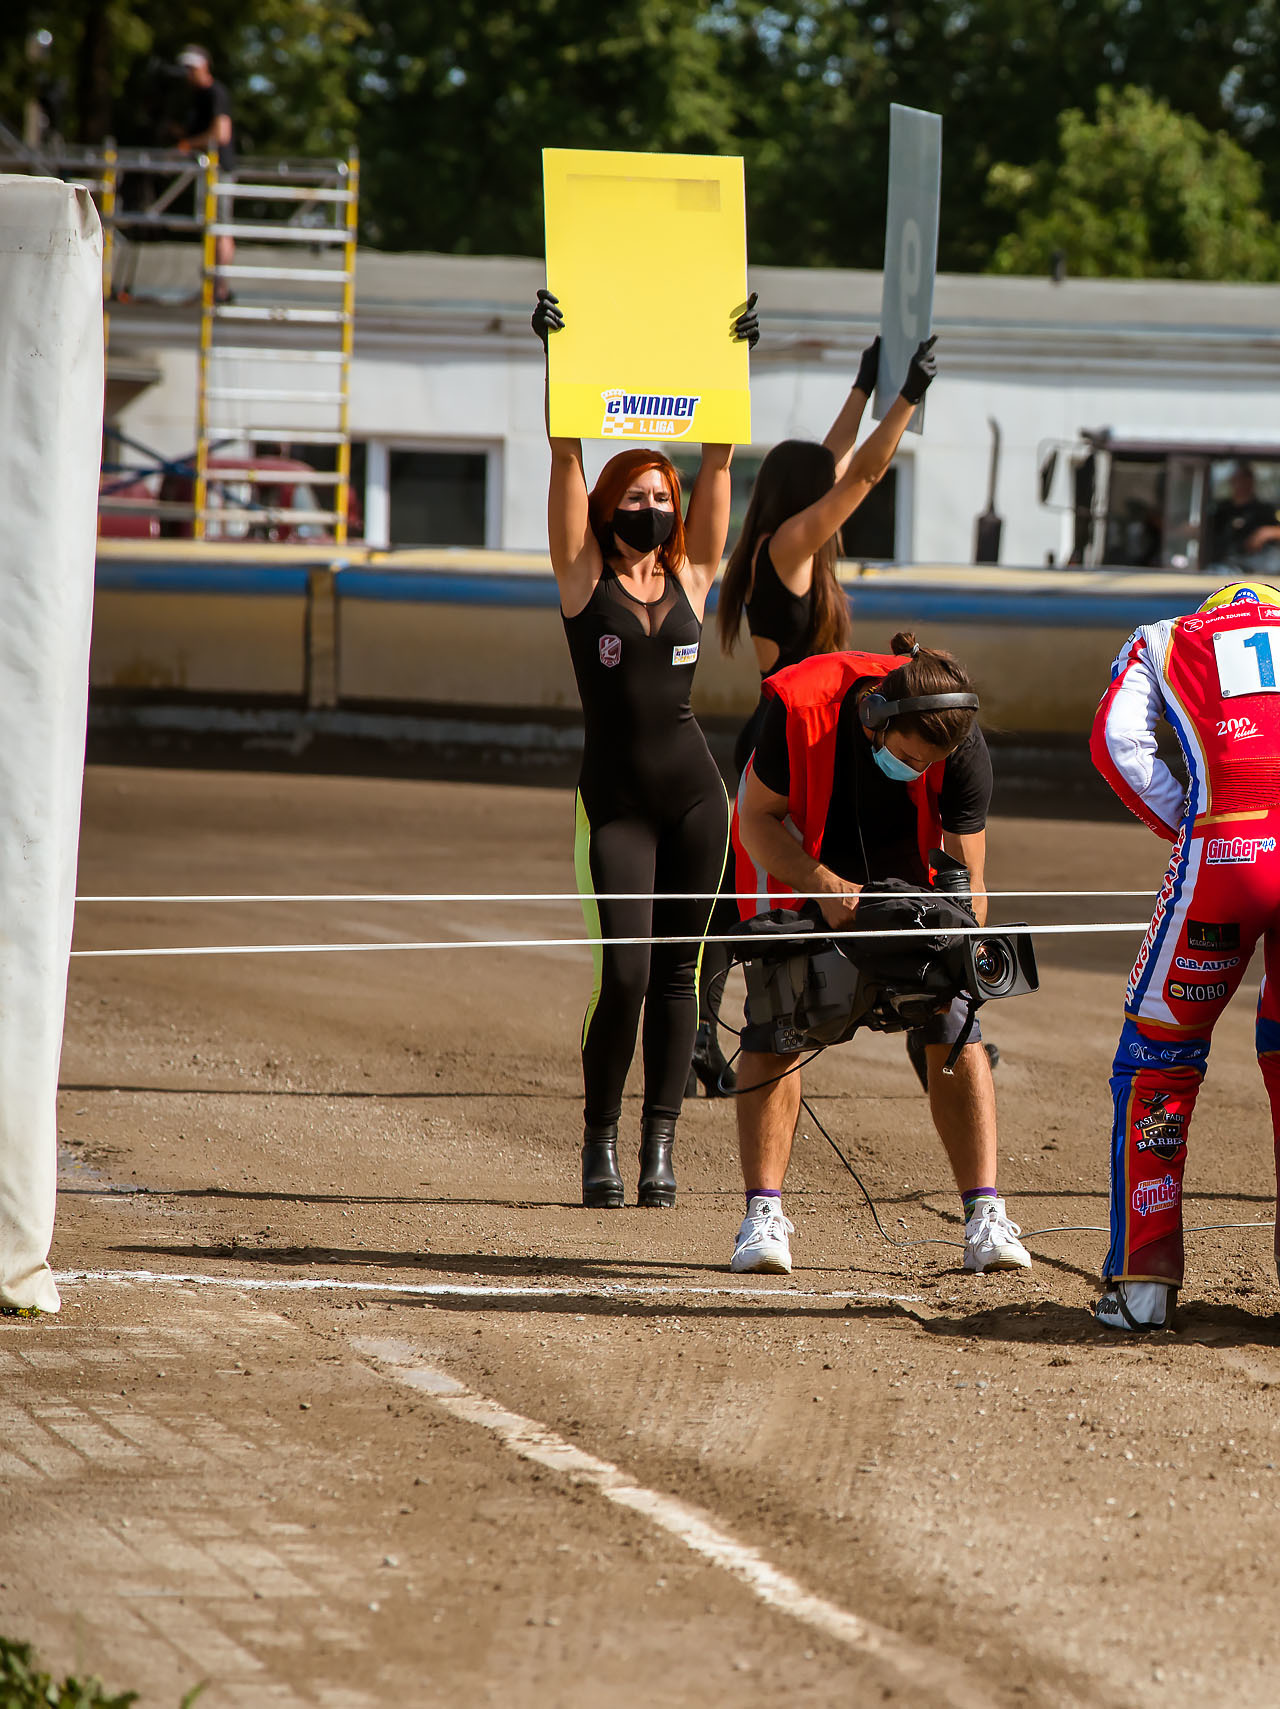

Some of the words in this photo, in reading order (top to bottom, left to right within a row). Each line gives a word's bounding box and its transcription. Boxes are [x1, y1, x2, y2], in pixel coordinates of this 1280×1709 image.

[607, 395, 699, 416] eWinner
[639, 420, 647, 432] 1.
[648, 420, 675, 433] LIGA
[1243, 632, 1276, 687] 1
[1207, 838, 1260, 861] GinGer
[1202, 957, 1239, 971] AUTO
[1186, 983, 1226, 1001] KOBO
[1134, 1115, 1154, 1130] FAST
[1133, 1183, 1180, 1210] GinGer
